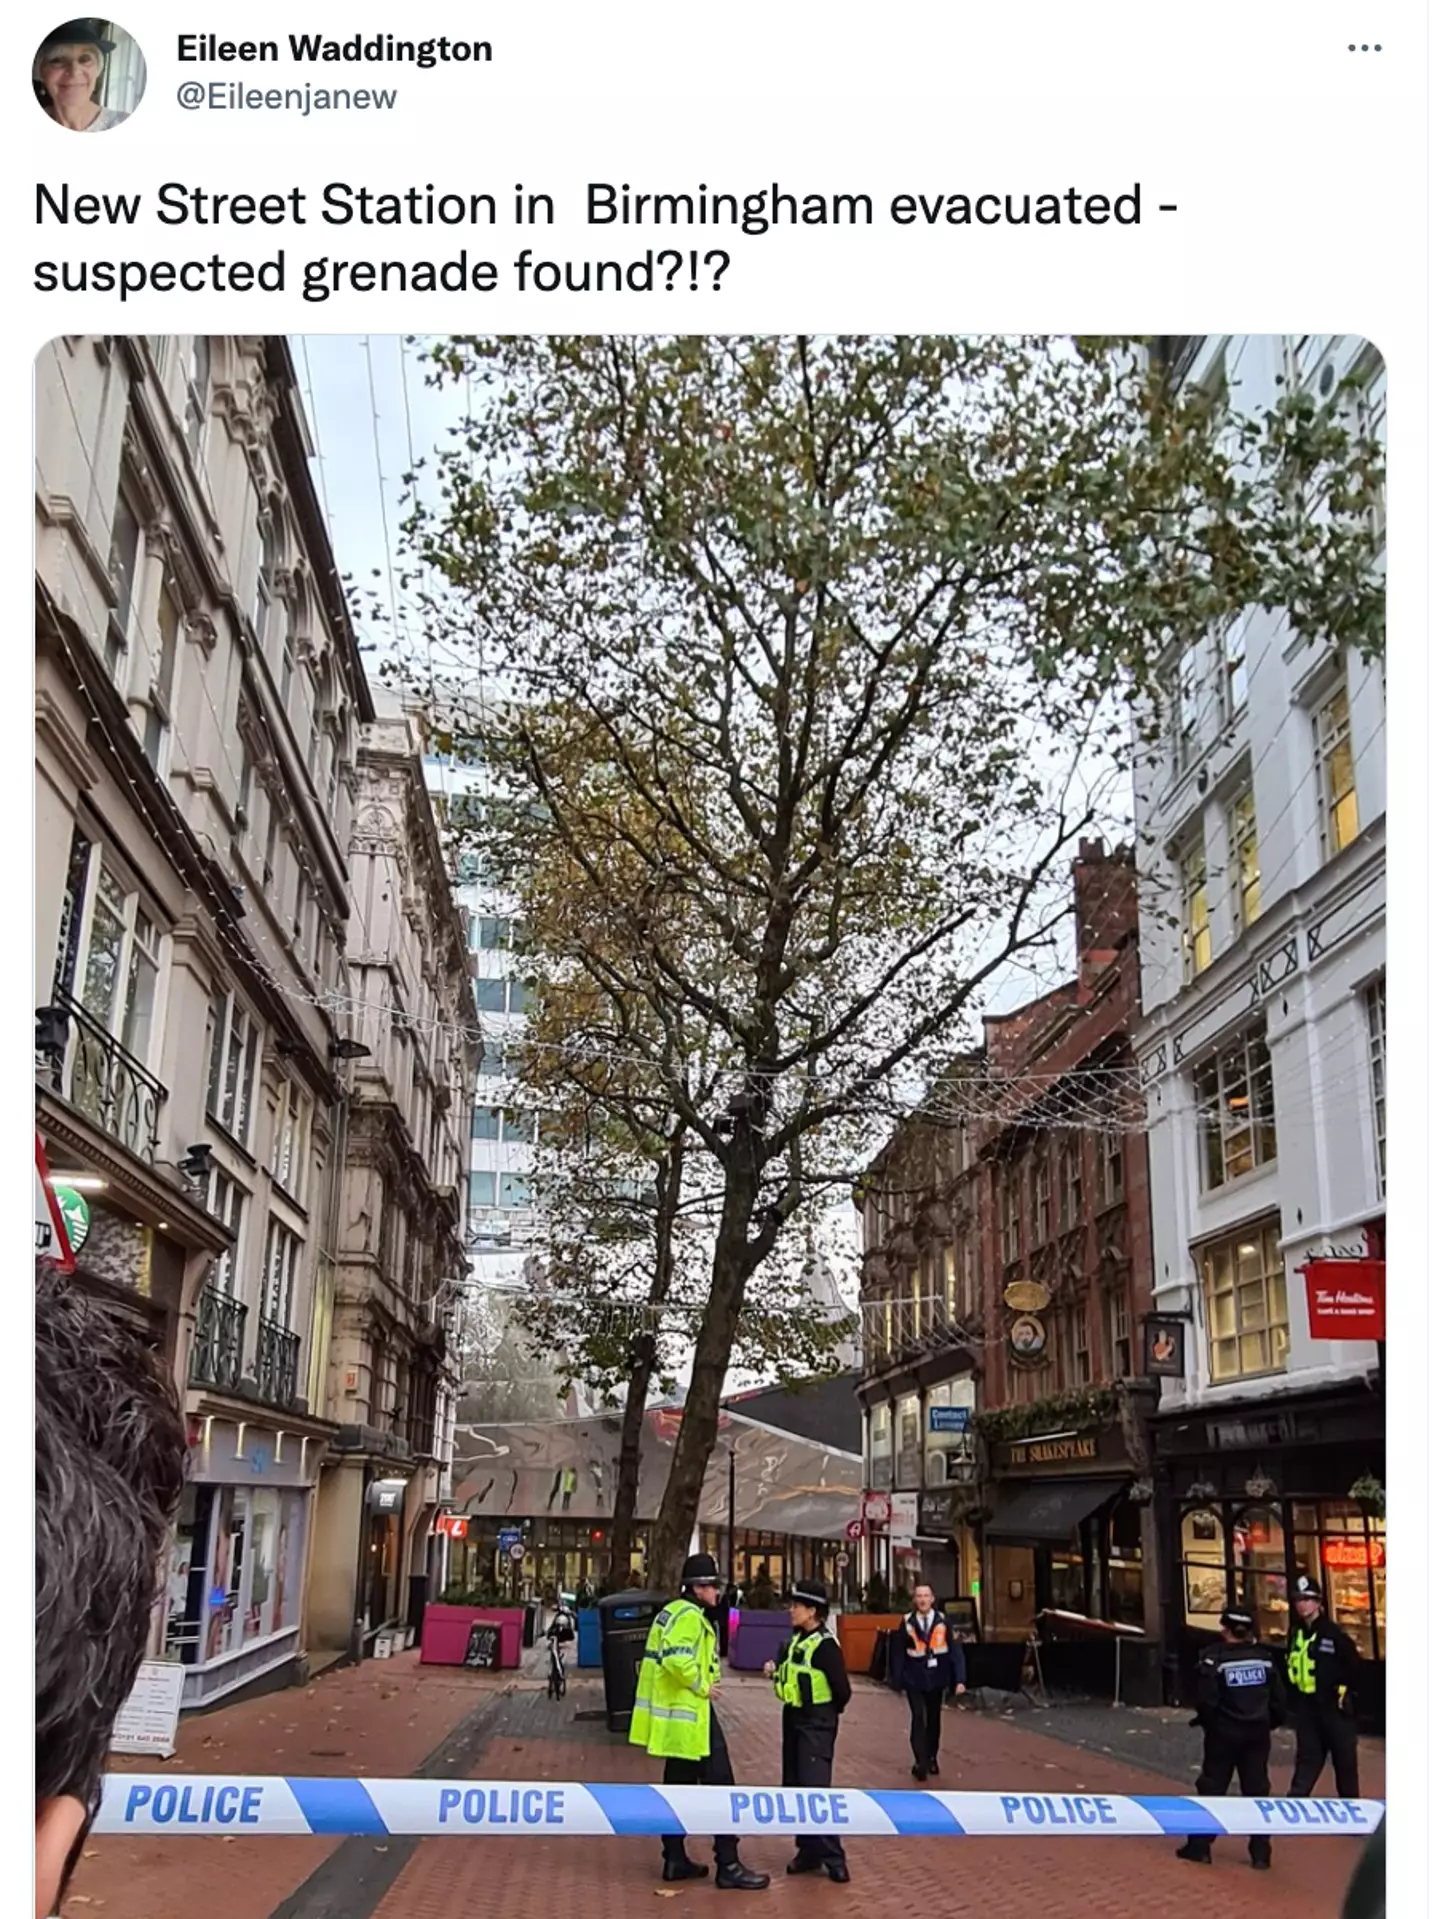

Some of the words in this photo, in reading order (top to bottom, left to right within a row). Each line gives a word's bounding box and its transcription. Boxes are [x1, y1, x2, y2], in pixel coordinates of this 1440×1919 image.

[931, 1408, 967, 1420] Contact
[1227, 1666, 1265, 1685] POLICE
[125, 1785, 263, 1824] POLICE
[438, 1788, 564, 1824] POLICE
[731, 1792, 849, 1824] POLICE
[1004, 1796, 1117, 1824] POLICE
[1256, 1798, 1368, 1824] POLICE
